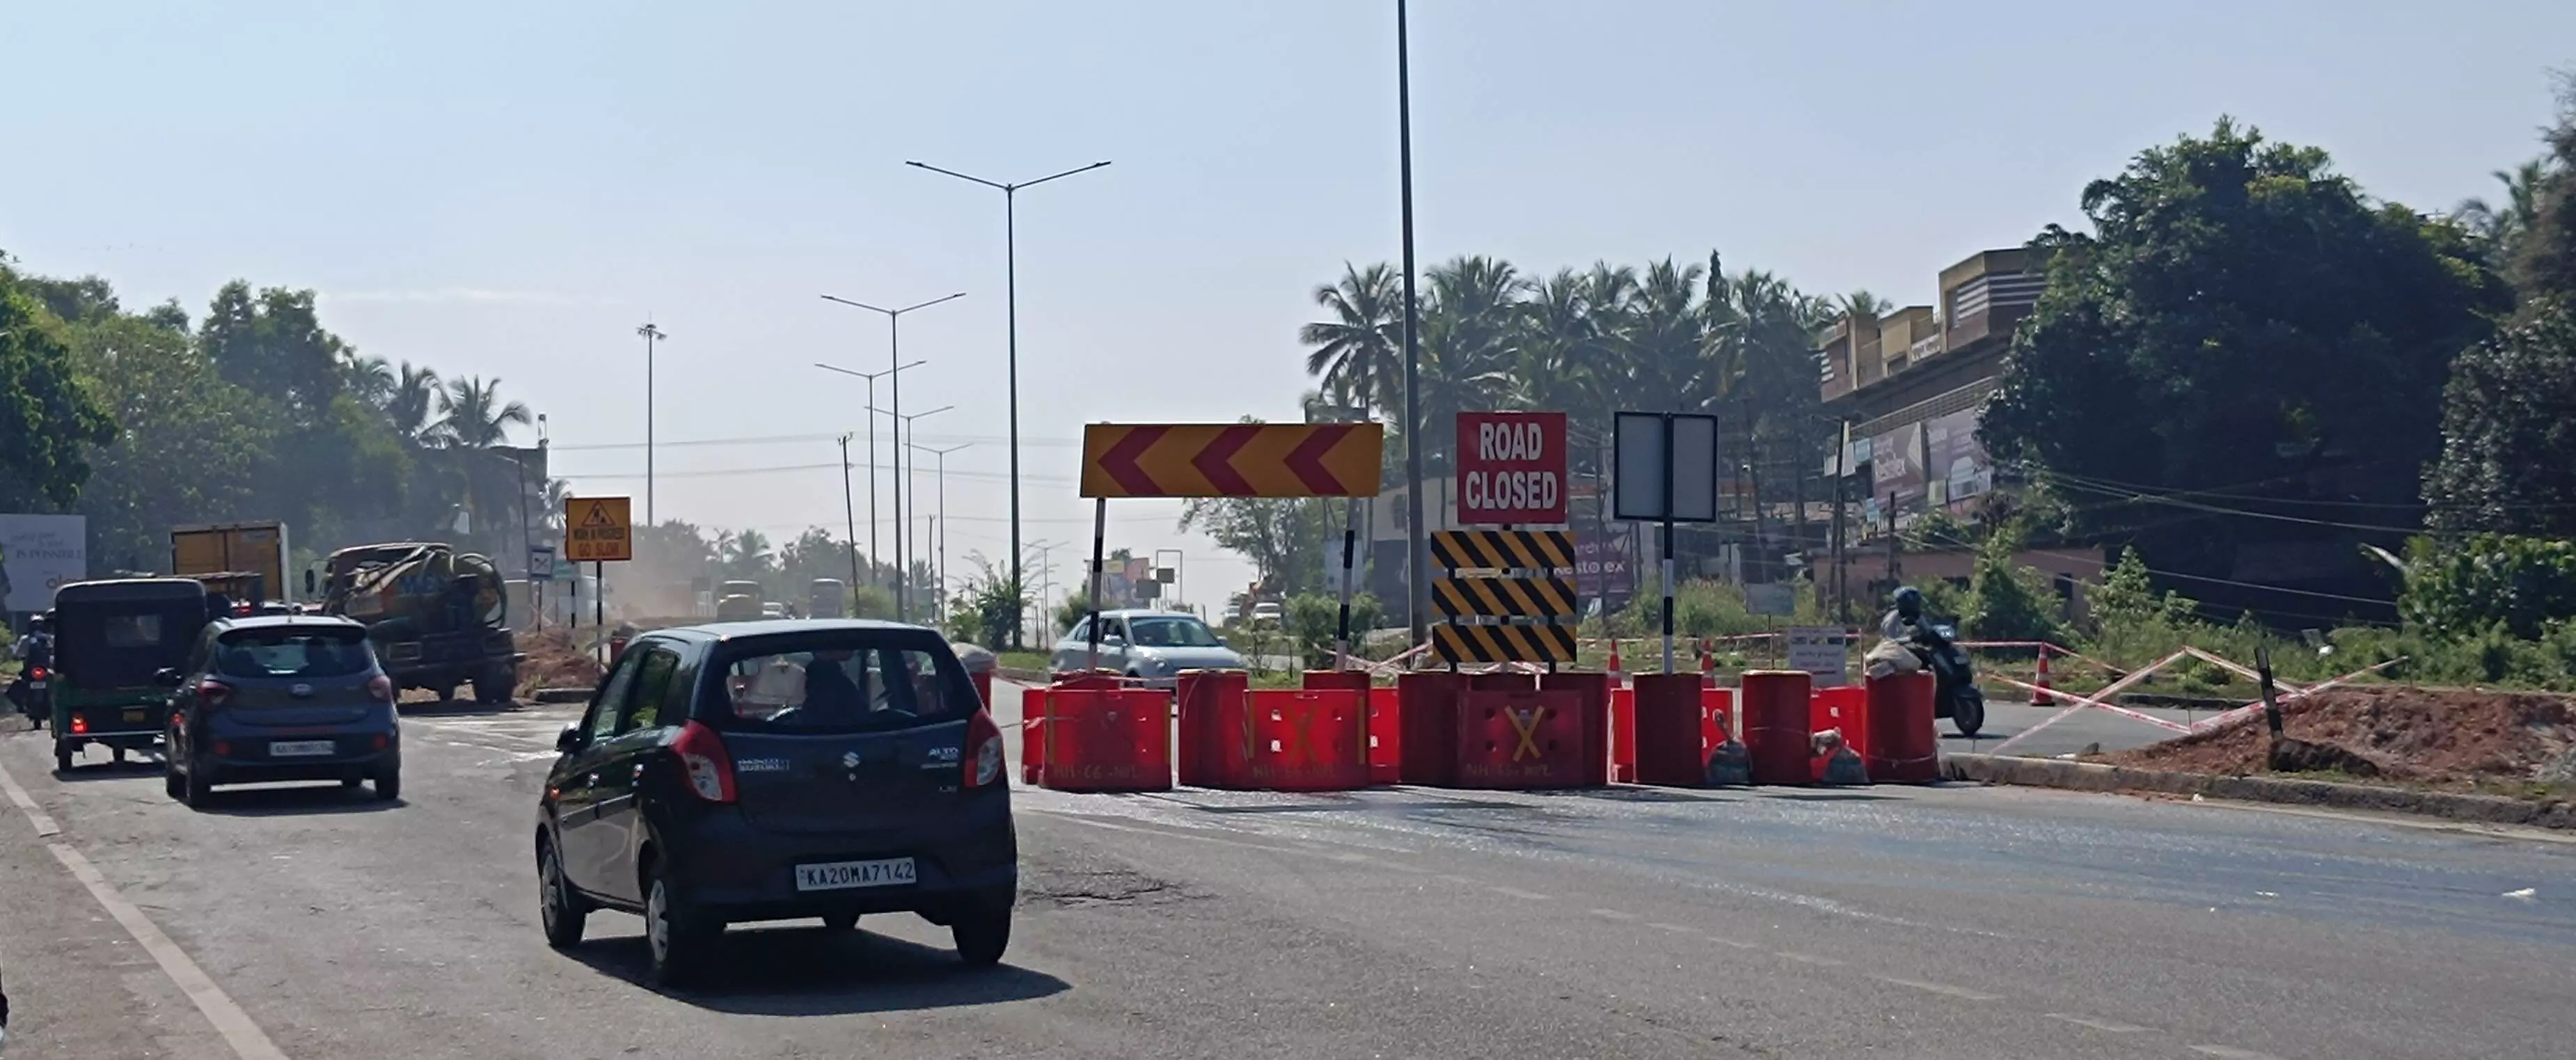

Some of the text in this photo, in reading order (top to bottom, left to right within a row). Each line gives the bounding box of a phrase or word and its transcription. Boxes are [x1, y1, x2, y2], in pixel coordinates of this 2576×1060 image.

[1479, 422, 1543, 461] ROAD
[1465, 470, 1558, 510] CLOSED
[578, 541, 620, 557] GO SLOW
[807, 862, 914, 886] KA20MA7142
